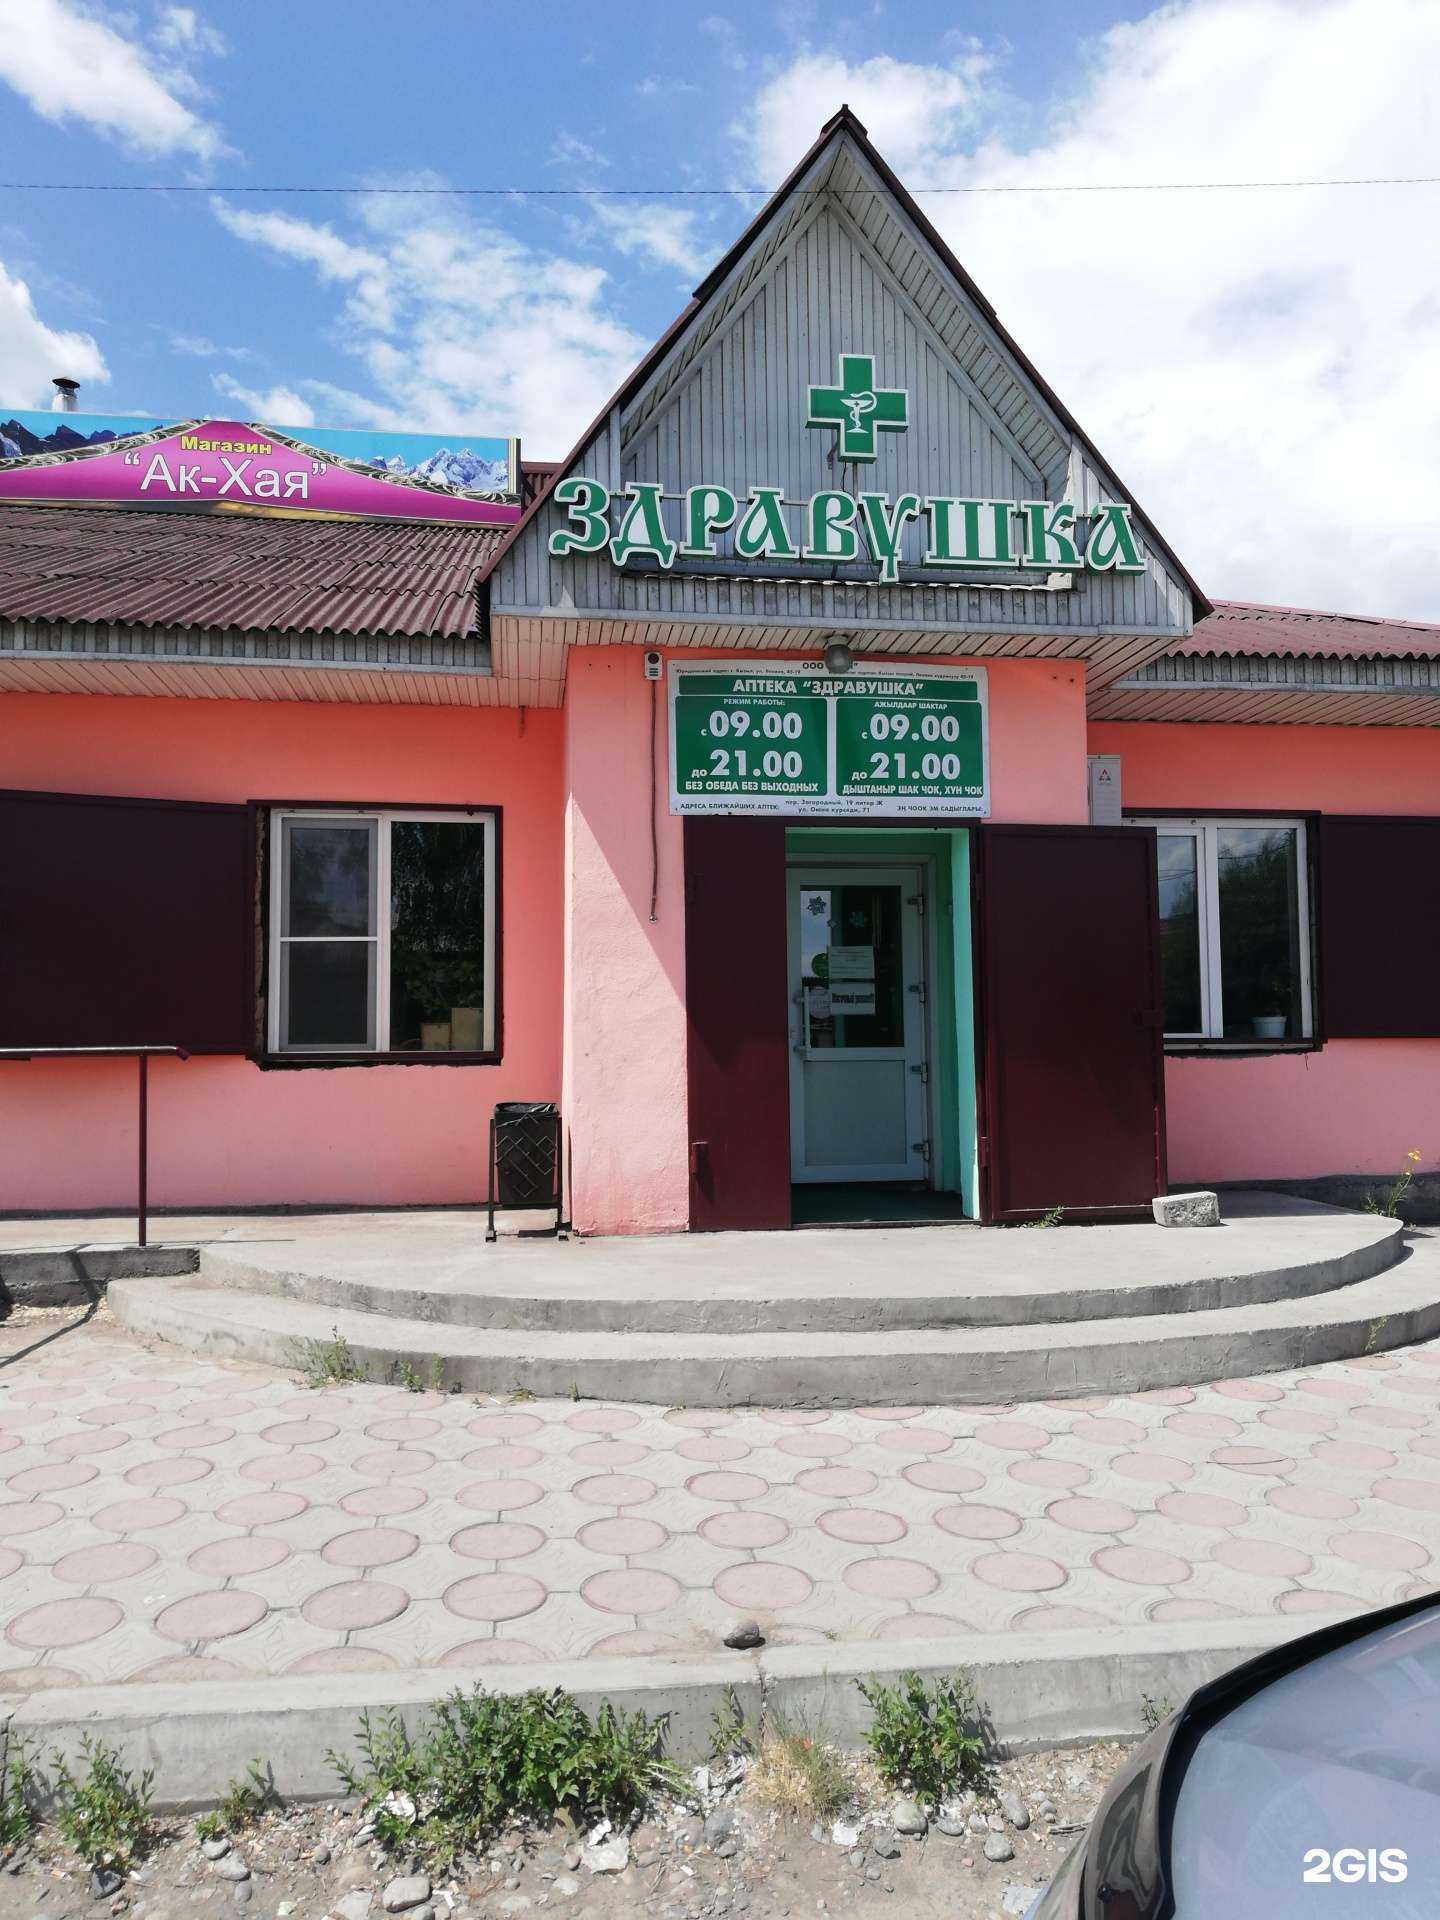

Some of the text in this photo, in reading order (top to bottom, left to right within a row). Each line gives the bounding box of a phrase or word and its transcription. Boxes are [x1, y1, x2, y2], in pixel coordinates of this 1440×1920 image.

[181, 435, 272, 455] Магазин
[548, 477, 1149, 586] ЗДРАВУШКА
[732, 679, 798, 694] АПТЕКА
[723, 698, 786, 706] РЕЖИМ РАБОТЫ:
[874, 701, 948, 710] АЖЫЛДААР ШАКТАР
[709, 710, 803, 740] 09.00
[869, 713, 960, 742] 09.00
[691, 749, 803, 779] до 21.00
[851, 752, 961, 781] до 21.00
[685, 781, 819, 793] БЕЗ ОБЕДА БЕЗ ВЫХОДНЫХ
[842, 785, 896, 796] ДЫШТАНЫР
[898, 785, 918, 795] ШАК
[921, 785, 942, 797] ЧОК,
[964, 785, 983, 796] ЧОК
[708, 802, 755, 810] БЛИЖАЙШИХ
